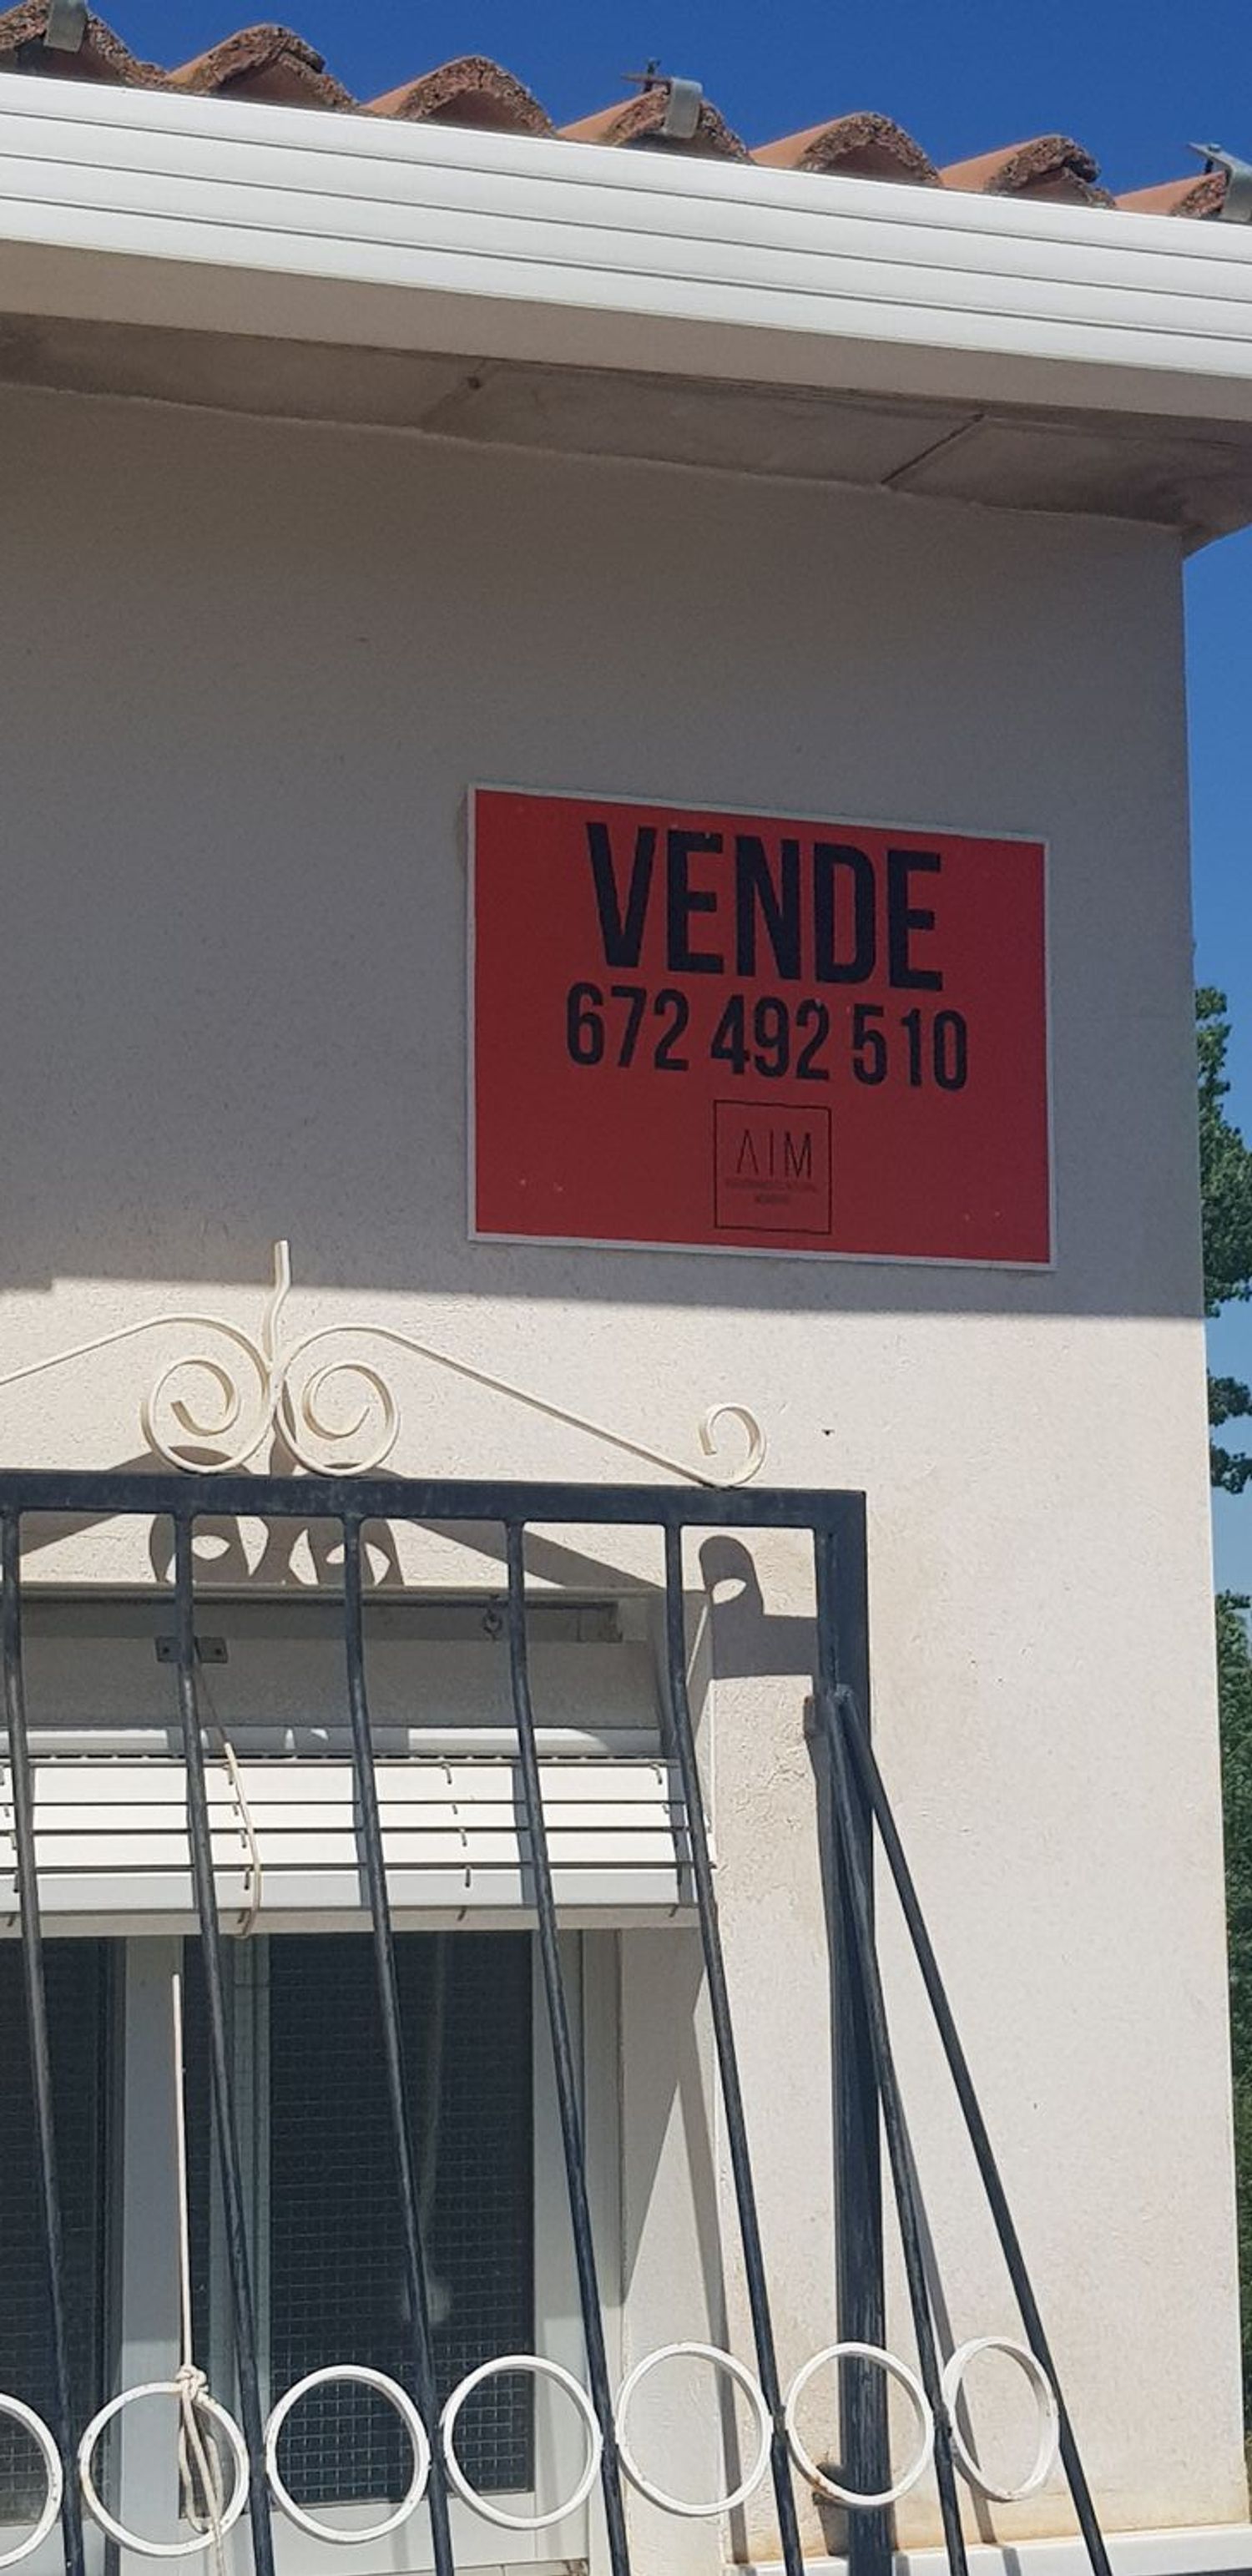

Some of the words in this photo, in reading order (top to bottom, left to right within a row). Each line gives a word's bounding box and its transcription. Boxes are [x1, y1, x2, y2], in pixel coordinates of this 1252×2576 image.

[587, 823, 942, 991] VENDE
[566, 982, 689, 1071] 672
[710, 994, 830, 1080] 492
[852, 1004, 968, 1091] 510
[736, 1129, 811, 1179] AIM
